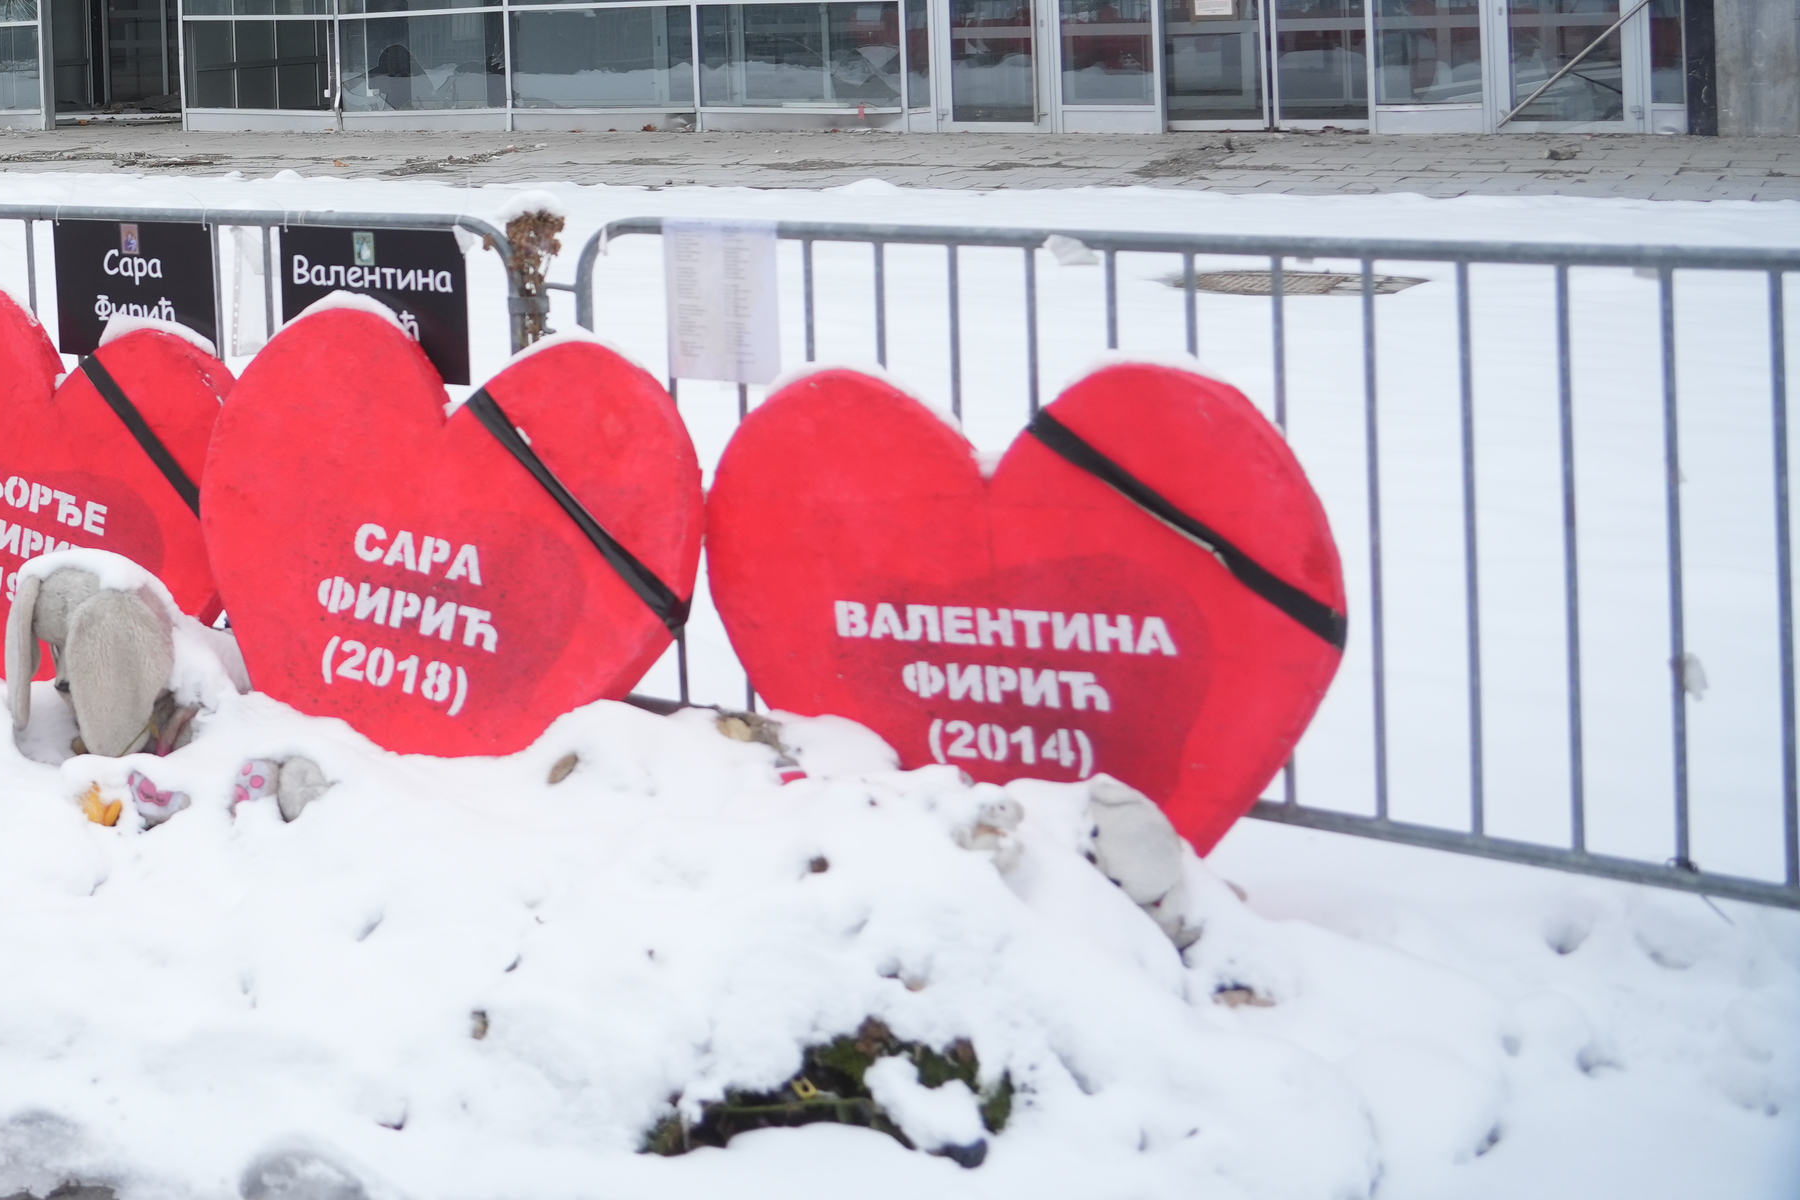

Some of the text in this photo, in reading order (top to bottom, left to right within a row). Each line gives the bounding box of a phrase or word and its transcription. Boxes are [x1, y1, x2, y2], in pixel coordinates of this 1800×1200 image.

[103, 248, 163, 286] Сара
[292, 254, 454, 293] Валентина
[354, 522, 482, 587] САРА
[318, 575, 498, 653] ФИРИЋ
[833, 599, 1177, 657] ВАЛЕНТИНА
[320, 635, 468, 717] (2018)
[902, 660, 1111, 712] ФИРИЋ
[928, 718, 1094, 779] (2014)
